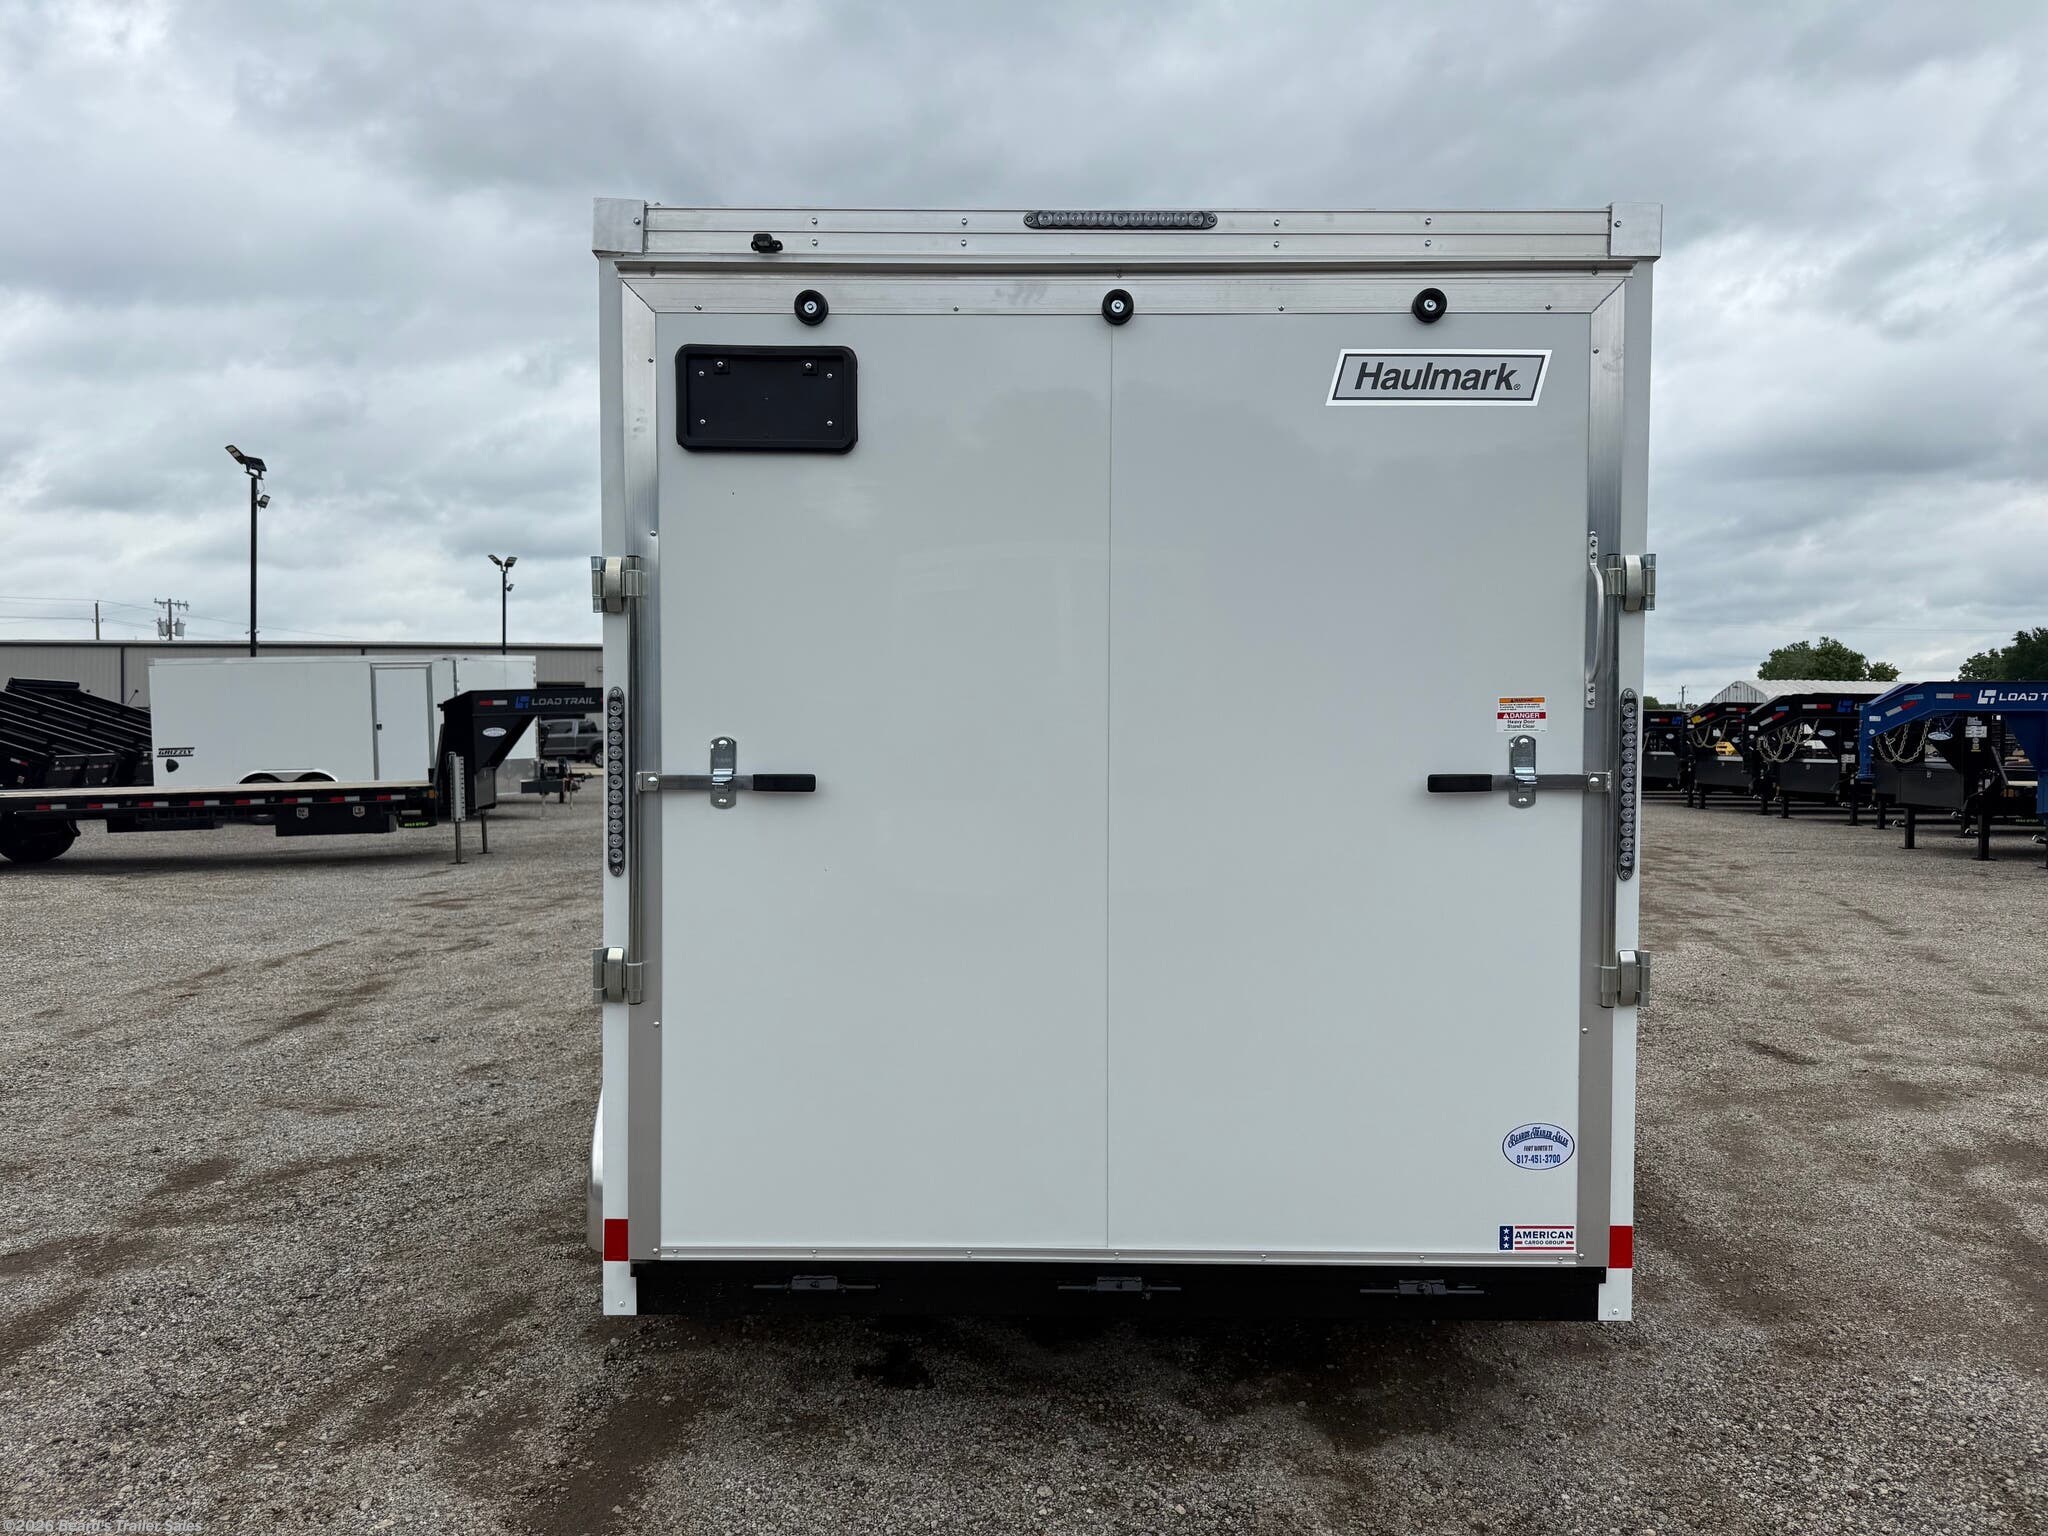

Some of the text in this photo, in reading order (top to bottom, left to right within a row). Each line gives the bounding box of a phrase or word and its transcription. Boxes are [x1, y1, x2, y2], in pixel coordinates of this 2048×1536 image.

[1354, 362, 1518, 390] Haulmark
[1999, 692, 2038, 701] LOAD
[531, 698, 562, 706] LOAD
[564, 697, 596, 705] TRAIL
[1516, 1154, 1561, 1164] 817-451-3700
[1514, 1231, 1574, 1239] AMERICAN
